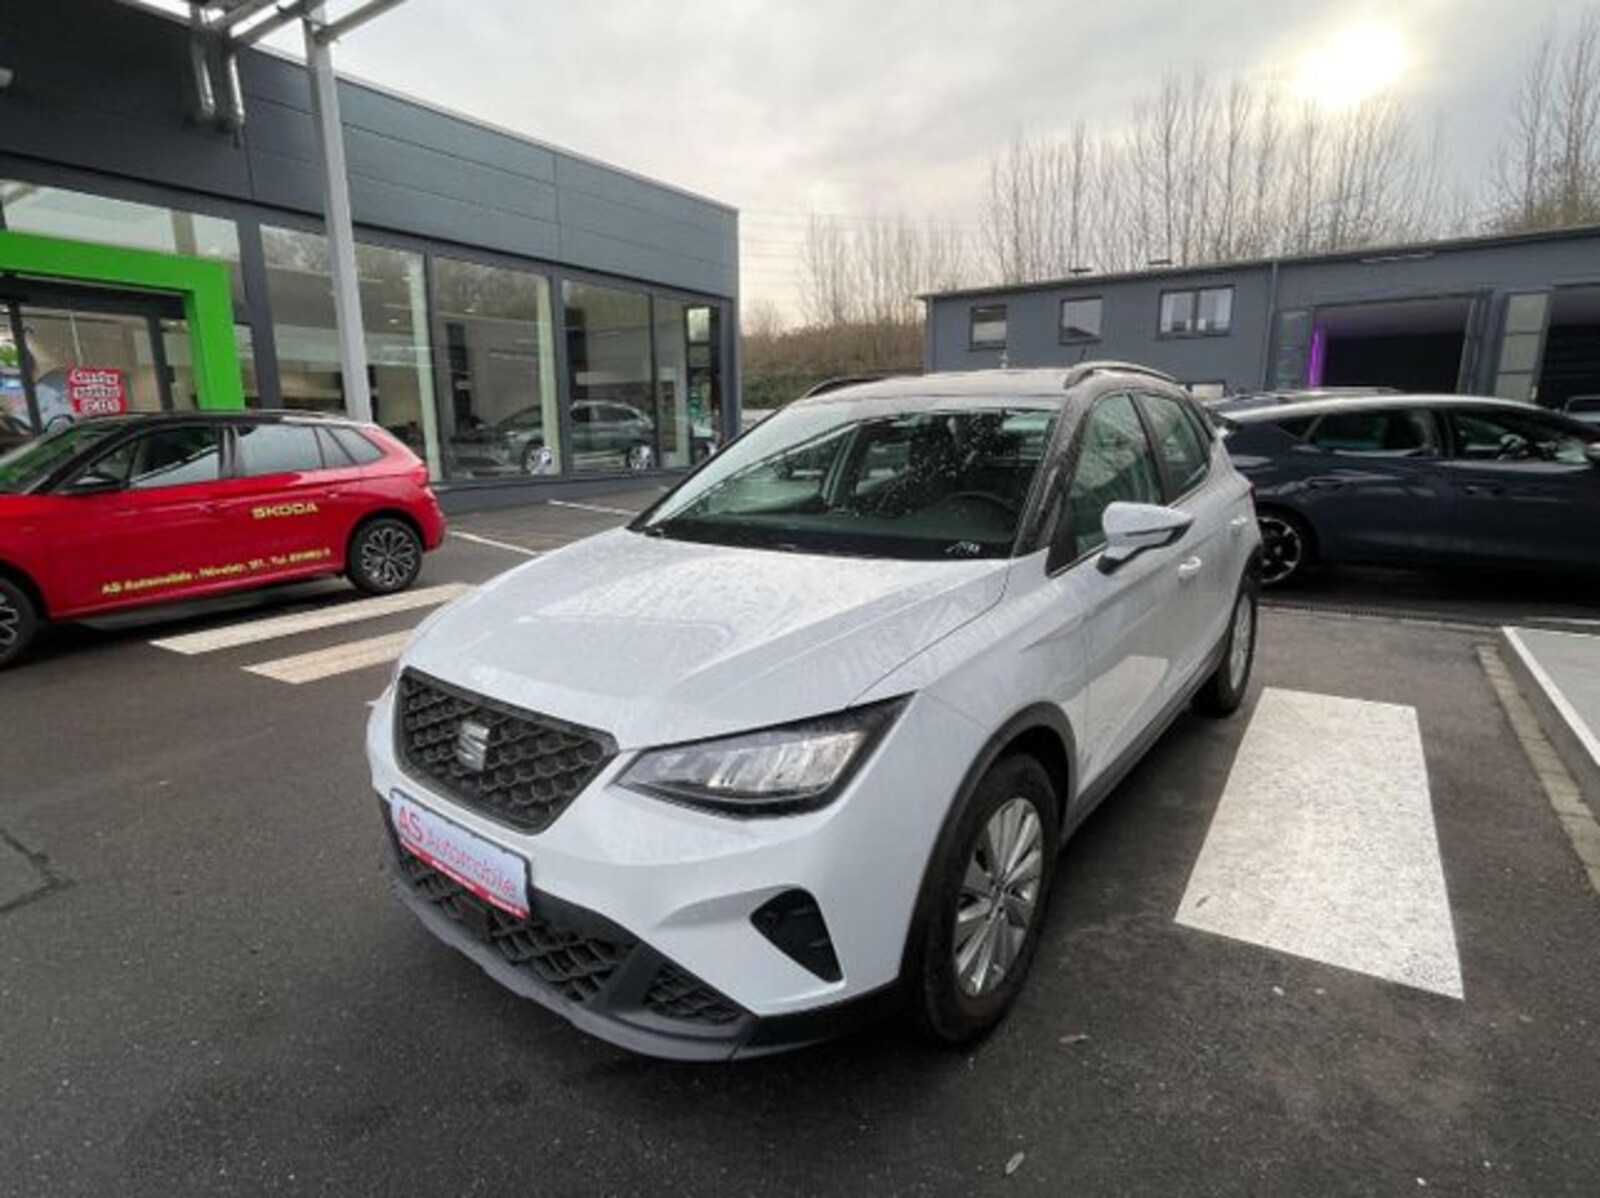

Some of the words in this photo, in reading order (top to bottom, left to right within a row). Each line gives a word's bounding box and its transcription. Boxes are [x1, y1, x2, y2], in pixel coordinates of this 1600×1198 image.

[101, 581, 122, 595] AS
[399, 805, 423, 841] AS
[423, 828, 517, 897] Automobile
